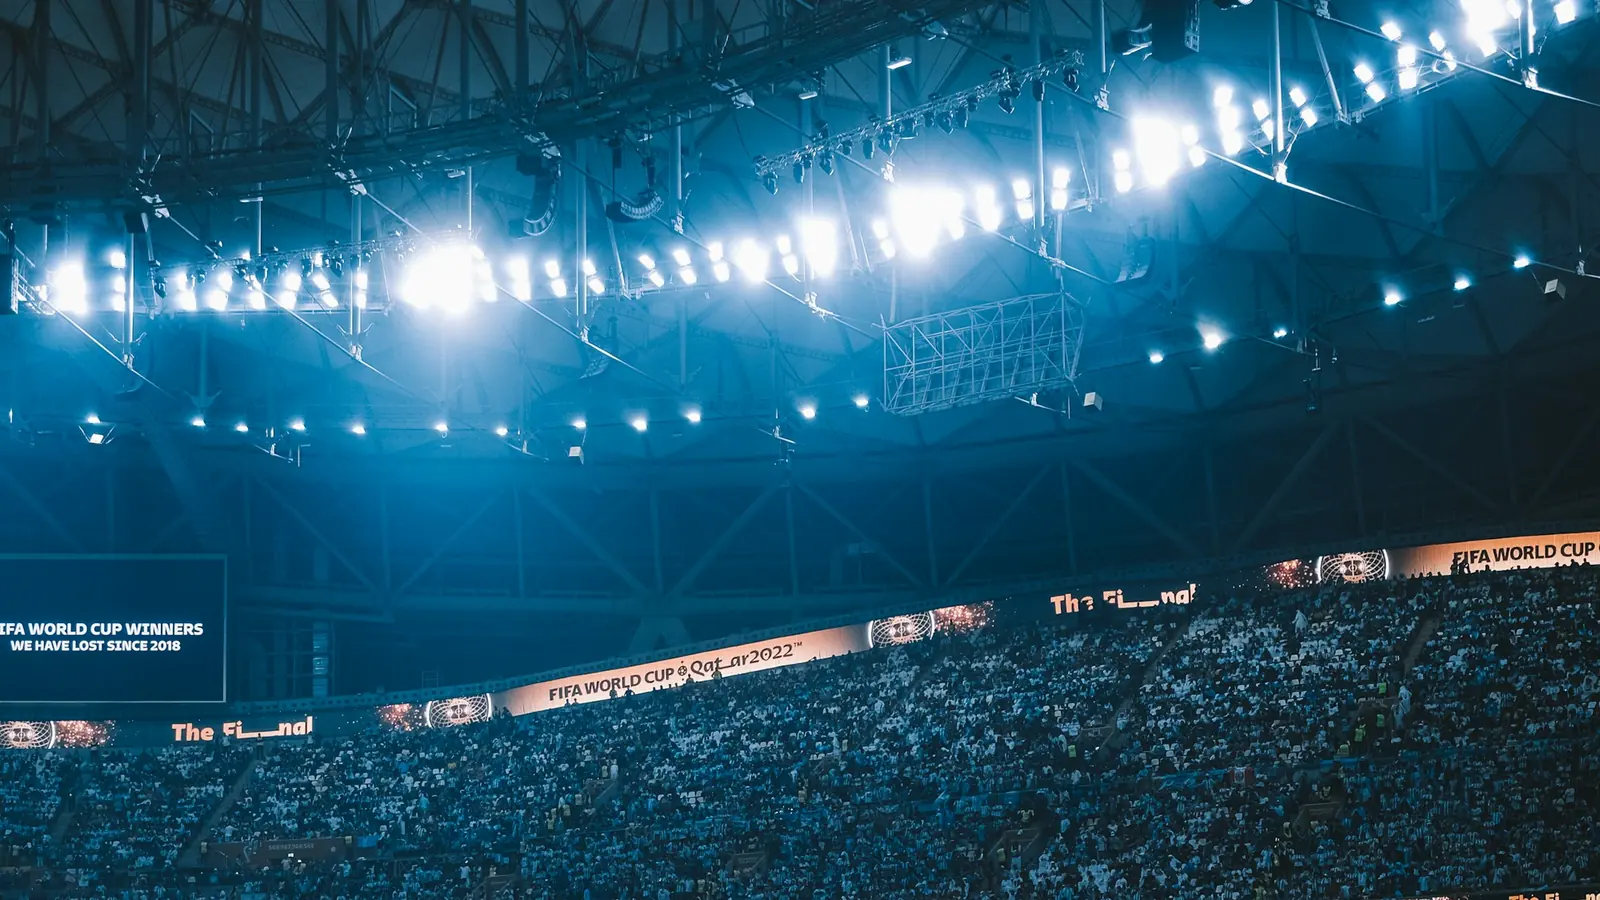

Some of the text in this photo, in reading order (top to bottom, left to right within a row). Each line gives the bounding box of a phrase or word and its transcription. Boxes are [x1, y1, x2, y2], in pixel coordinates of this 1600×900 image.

[1493, 544, 1557, 562] WORLD
[1560, 542, 1596, 557] CUP
[27, 622, 87, 636] WORLD
[90, 622, 123, 636] CUP
[125, 622, 204, 636] WINNERS
[10, 640, 181, 651] WE HAVE LOST SINCE 2018
[549, 684, 582, 701] FIFA
[584, 674, 642, 695] WORLD
[644, 667, 675, 684] CUP
[171, 722, 215, 742] The
